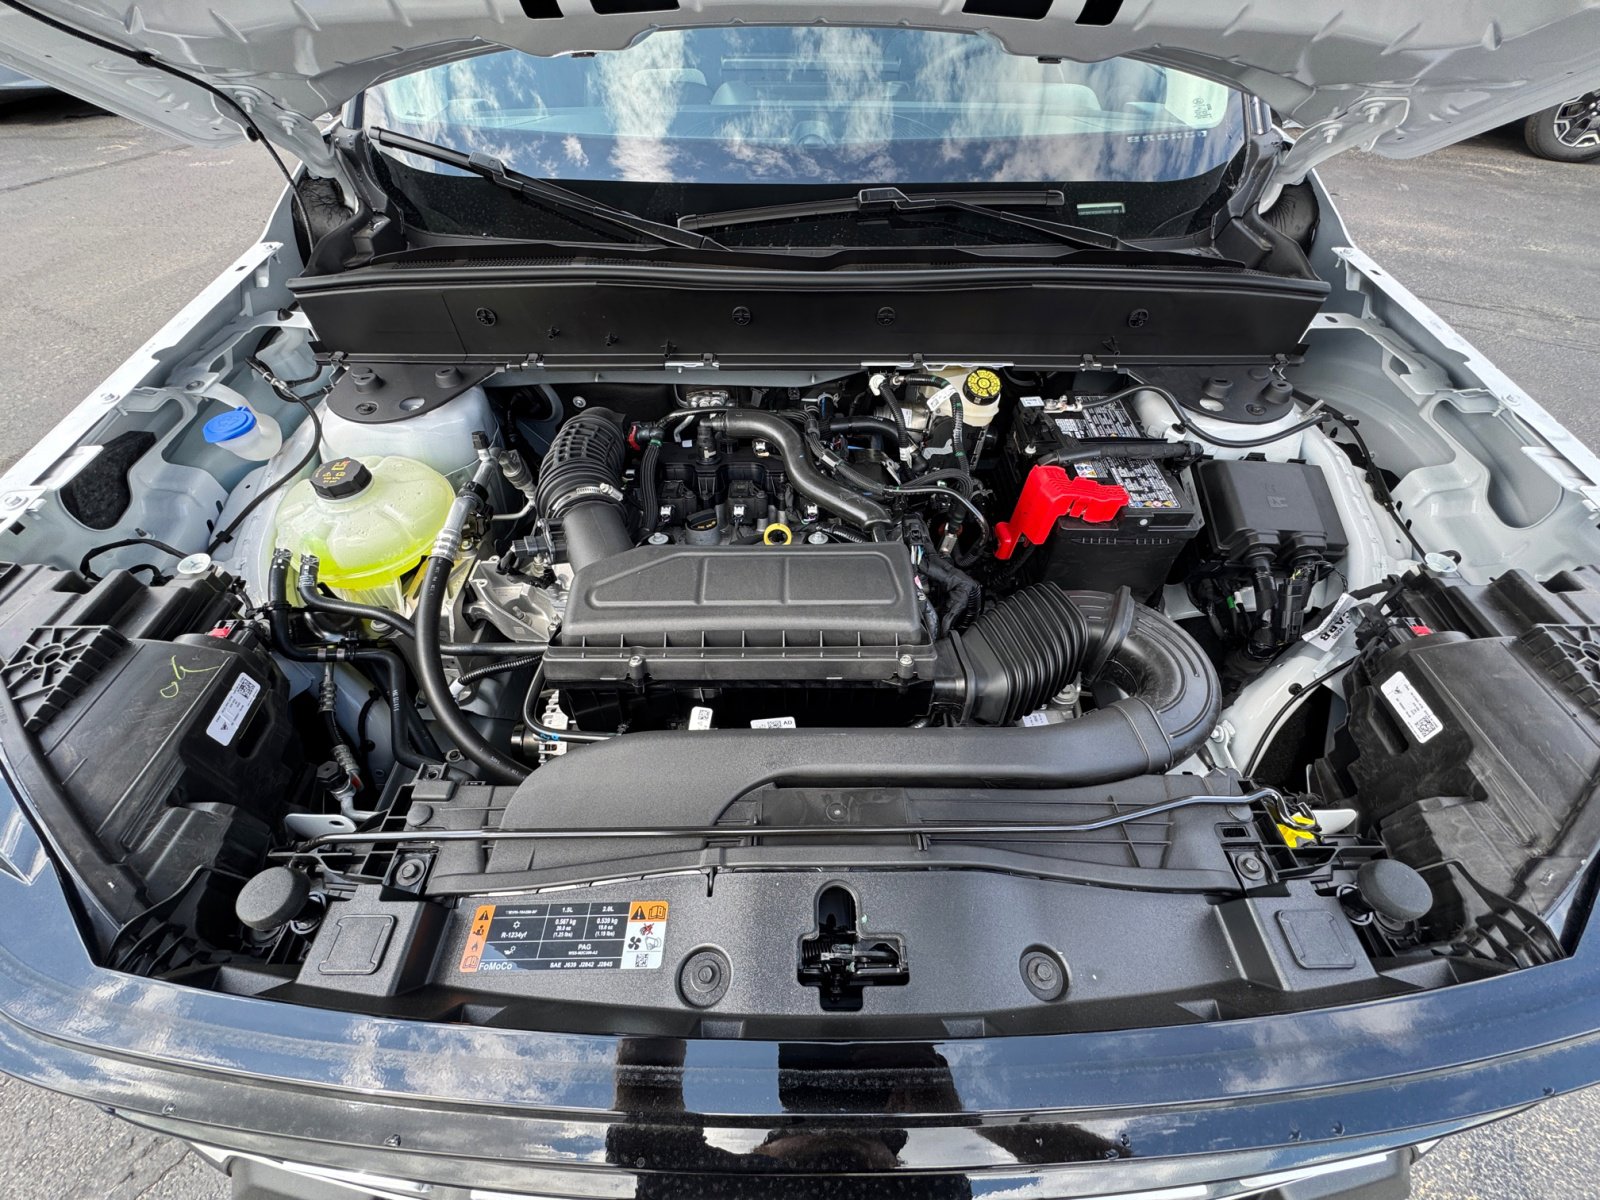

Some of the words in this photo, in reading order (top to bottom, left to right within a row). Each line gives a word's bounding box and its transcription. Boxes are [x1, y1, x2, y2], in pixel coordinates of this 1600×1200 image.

[569, 918, 577, 926] kg
[610, 917, 619, 926] kg
[501, 931, 528, 939] R-1234yf
[479, 962, 513, 971] FoMoCo
